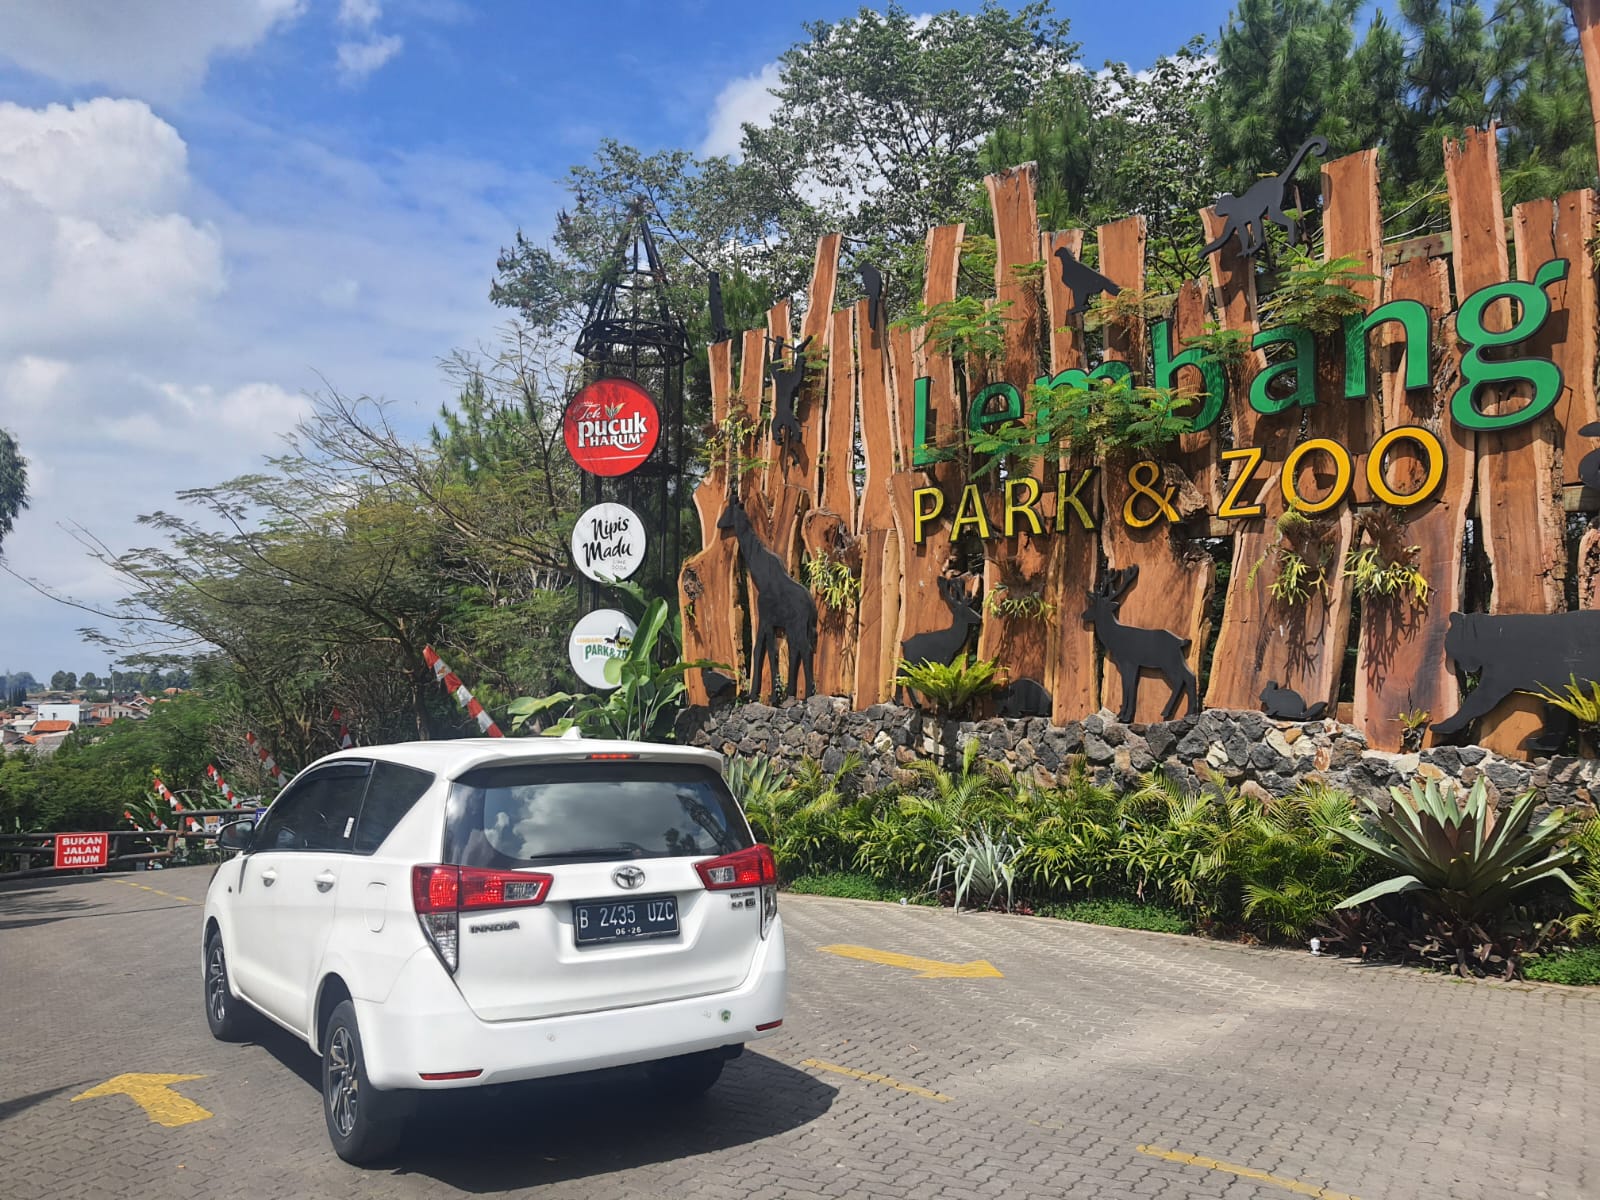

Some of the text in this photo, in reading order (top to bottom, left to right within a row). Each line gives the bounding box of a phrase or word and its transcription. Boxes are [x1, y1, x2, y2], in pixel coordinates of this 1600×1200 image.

[913, 259, 1568, 466] Lembang
[577, 411, 648, 448] pucuk
[589, 433, 643, 449] HARUM
[913, 425, 1446, 544] PARK & ZOO
[591, 516, 630, 541] Nipis
[582, 535, 633, 567] Madu
[62, 836, 103, 846] BUKAN
[63, 846, 101, 855] JALAN
[63, 855, 100, 865] UMUM
[580, 901, 675, 929] B 2435 UZC
